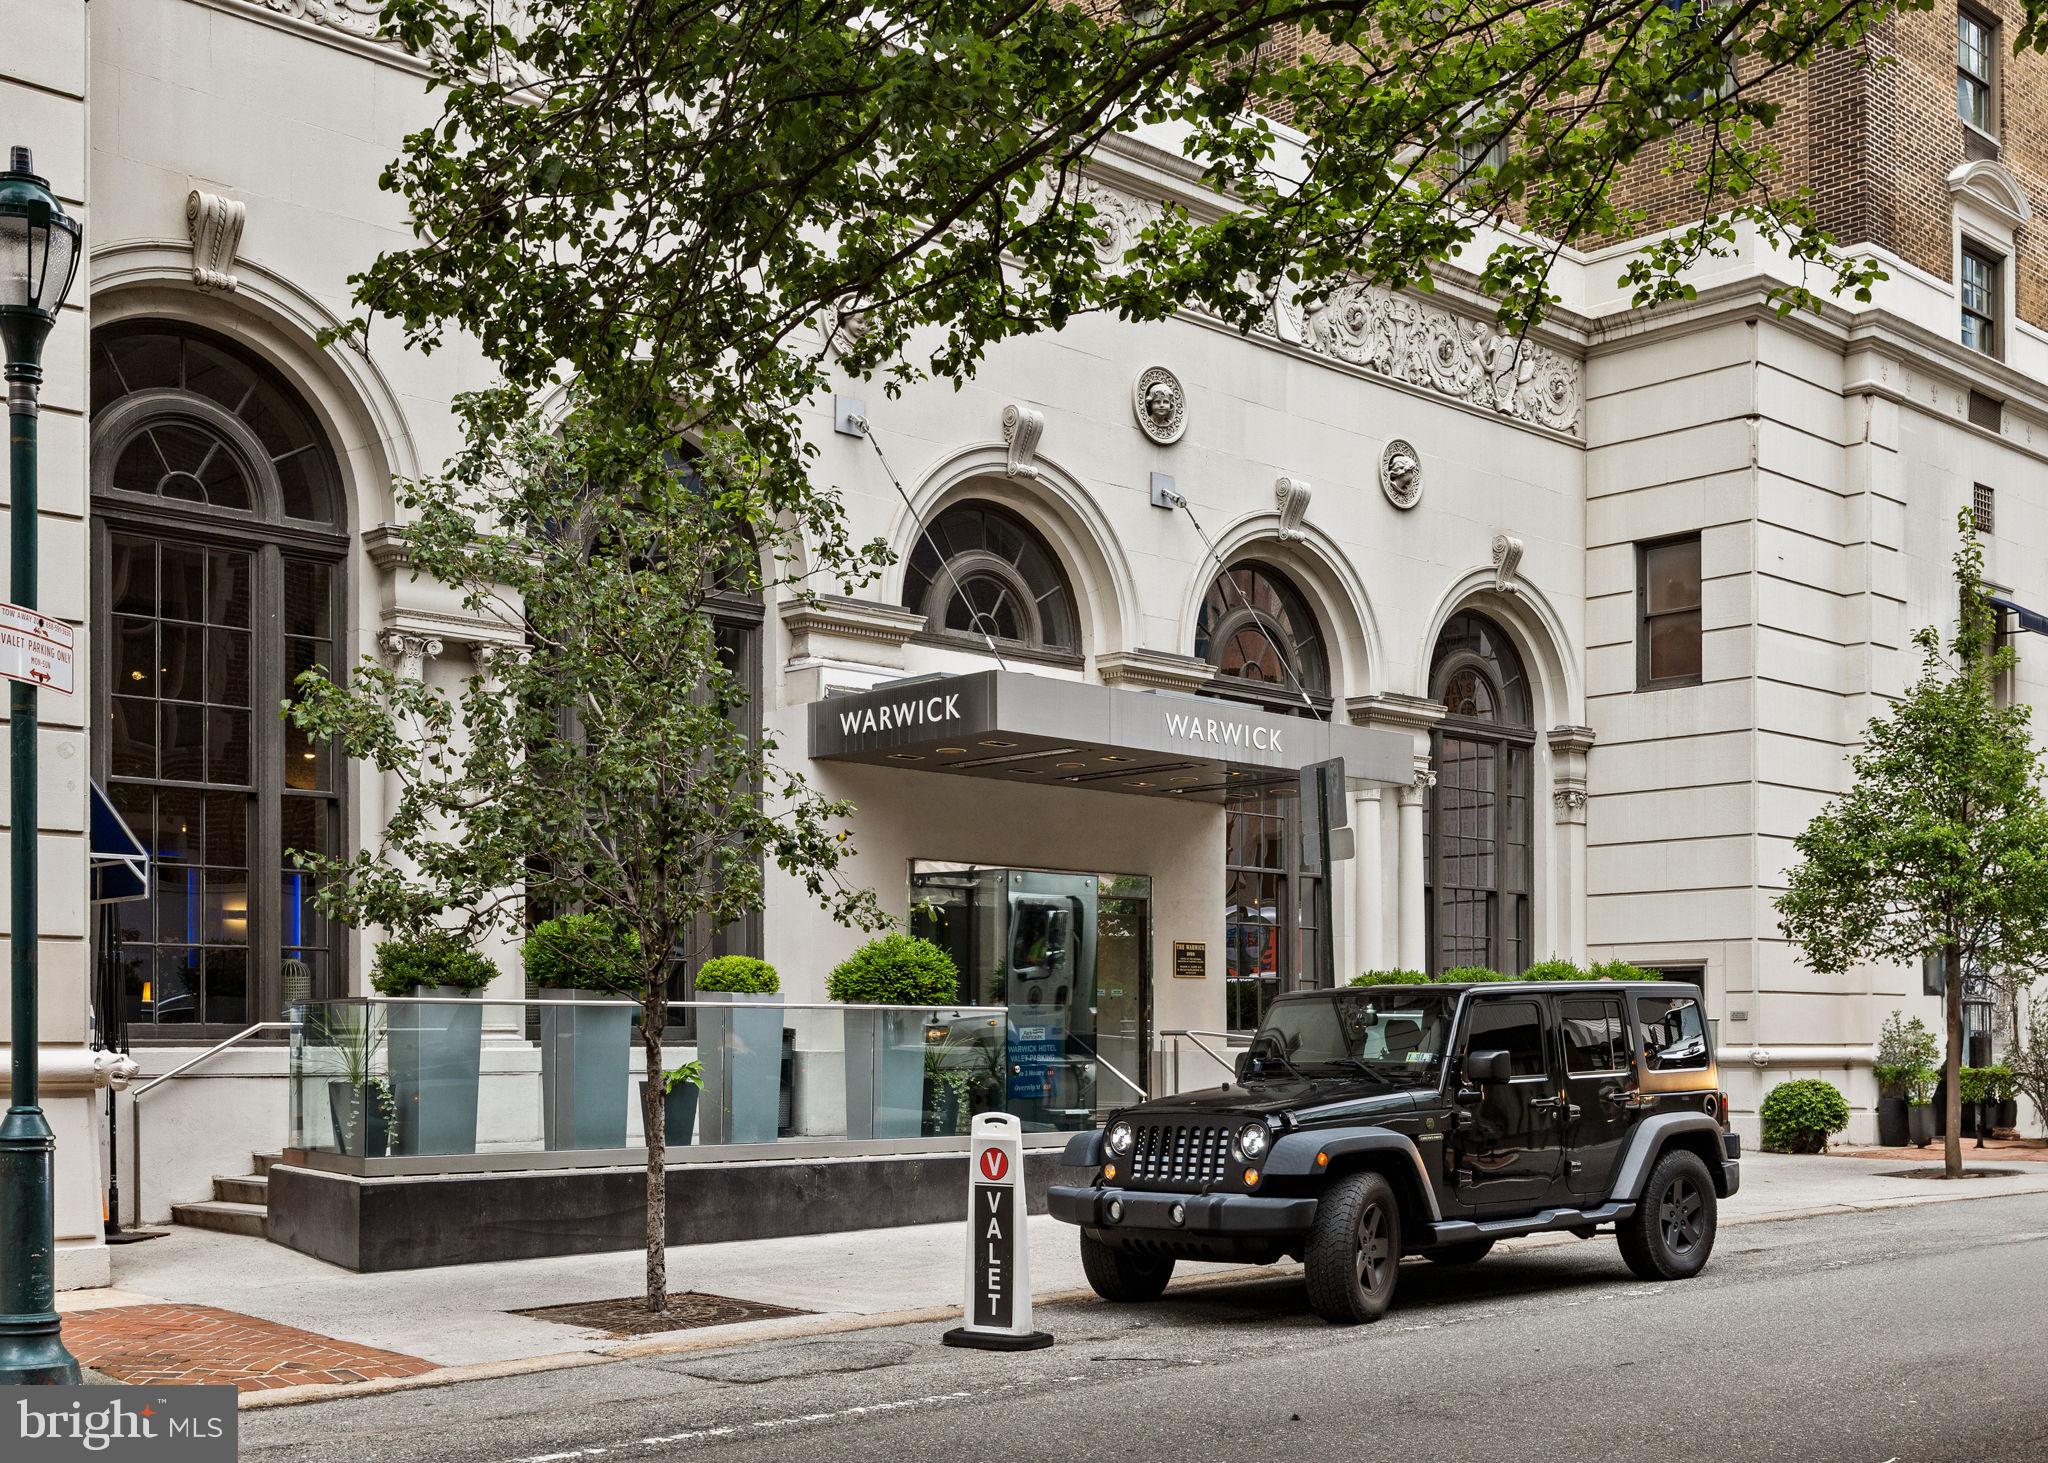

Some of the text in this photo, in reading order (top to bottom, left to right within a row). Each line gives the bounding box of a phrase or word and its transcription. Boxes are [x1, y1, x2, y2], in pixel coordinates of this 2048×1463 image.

[2, 608, 15, 617] TOW
[17, 613, 32, 623] AWAY
[1, 633, 71, 664] VALET PARKING ONLY
[31, 656, 51, 669] MON-SUN
[840, 694, 960, 736] WARWICK
[1165, 712, 1283, 753] WARWICK
[1008, 1044, 1057, 1053] WARWICK HOTEL
[986, 1152, 1002, 1176] V
[986, 1191, 1002, 1316] VALET
